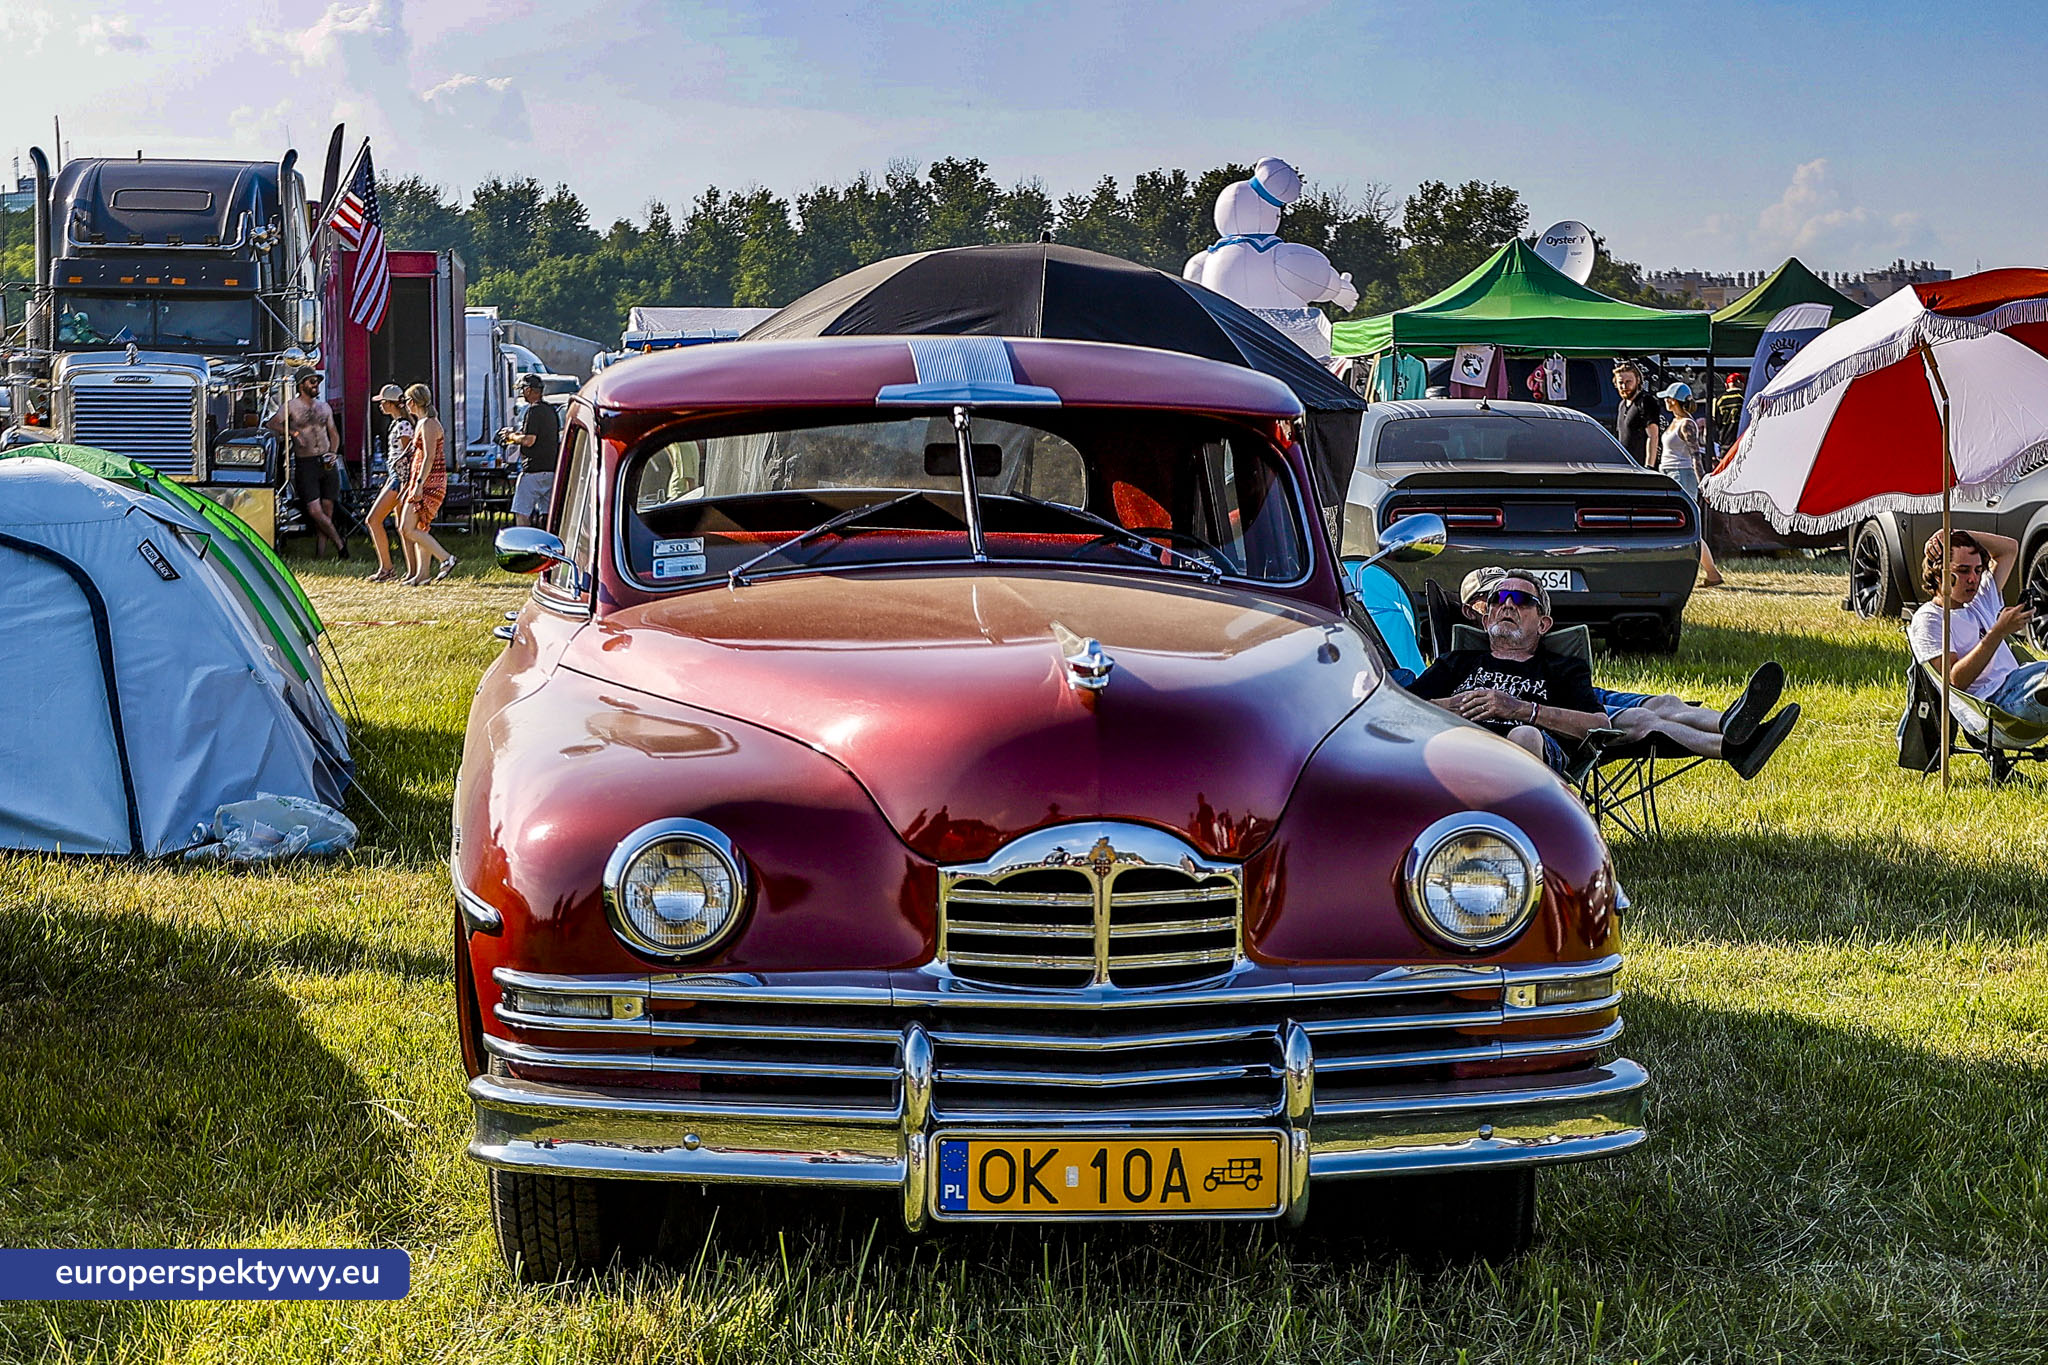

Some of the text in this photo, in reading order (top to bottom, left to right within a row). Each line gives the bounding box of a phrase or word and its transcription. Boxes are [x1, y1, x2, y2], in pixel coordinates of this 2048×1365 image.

[1546, 235, 1577, 247] Oyster
[978, 1147, 1191, 1204] OK 10A
[944, 1184, 964, 1200] PL
